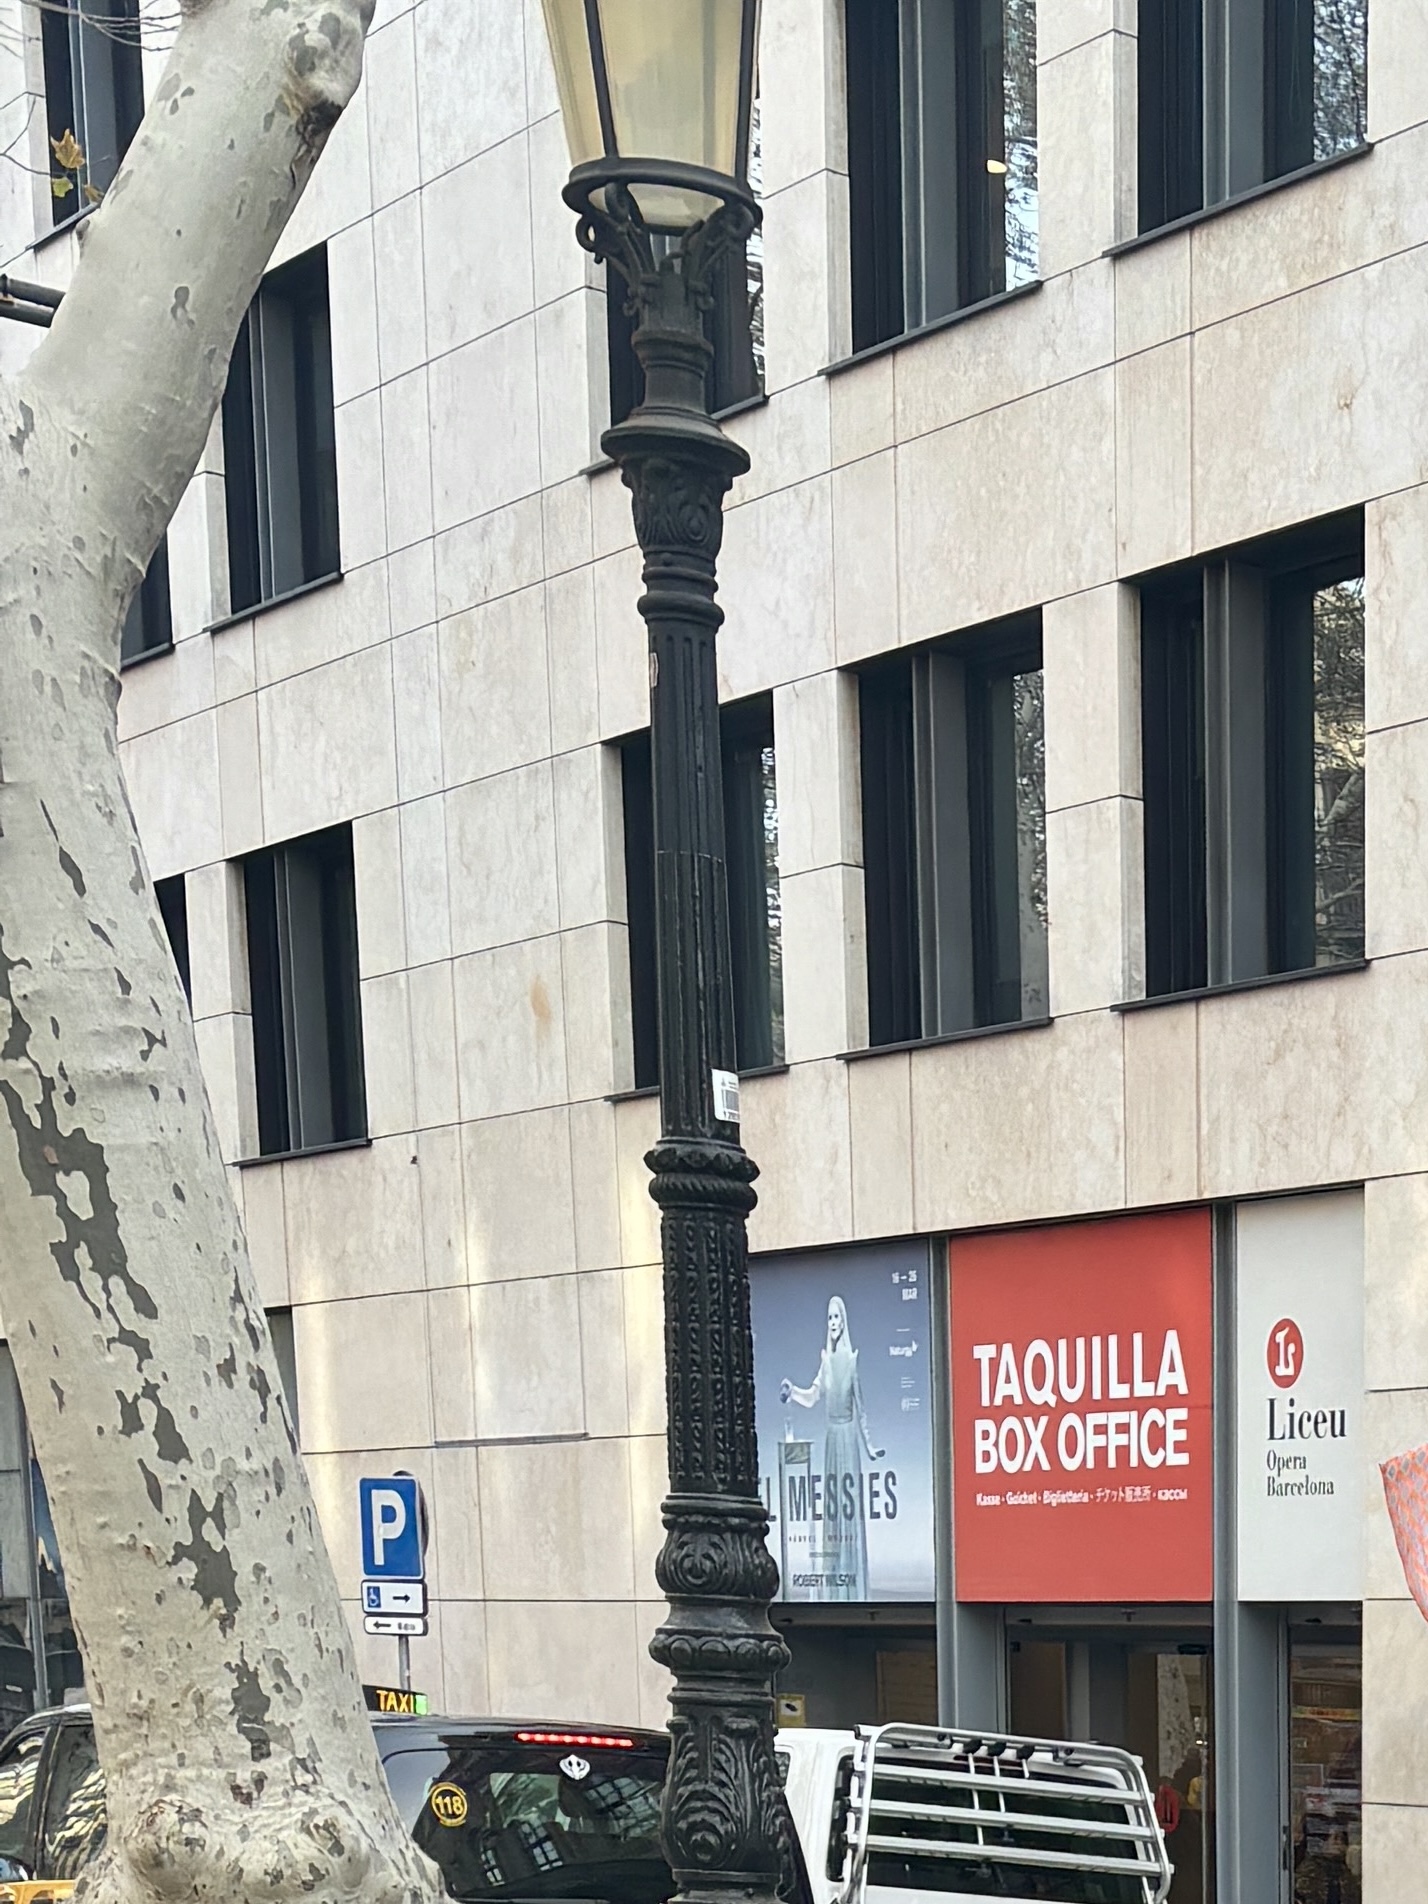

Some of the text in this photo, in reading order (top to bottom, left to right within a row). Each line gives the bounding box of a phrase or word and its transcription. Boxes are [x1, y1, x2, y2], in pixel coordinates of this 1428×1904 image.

[973, 1329, 1189, 1408] TAQUILLA
[974, 1407, 1190, 1474] BOX OFFICE
[1266, 1397, 1347, 1441] Liceu
[1266, 1449, 1307, 1477] Opera
[788, 1470, 898, 1522] MESSIES
[1266, 1475, 1335, 1497] Barcelona
[371, 1489, 406, 1565] P
[376, 1690, 414, 1713] TAXI
[436, 1795, 464, 1815] 118
